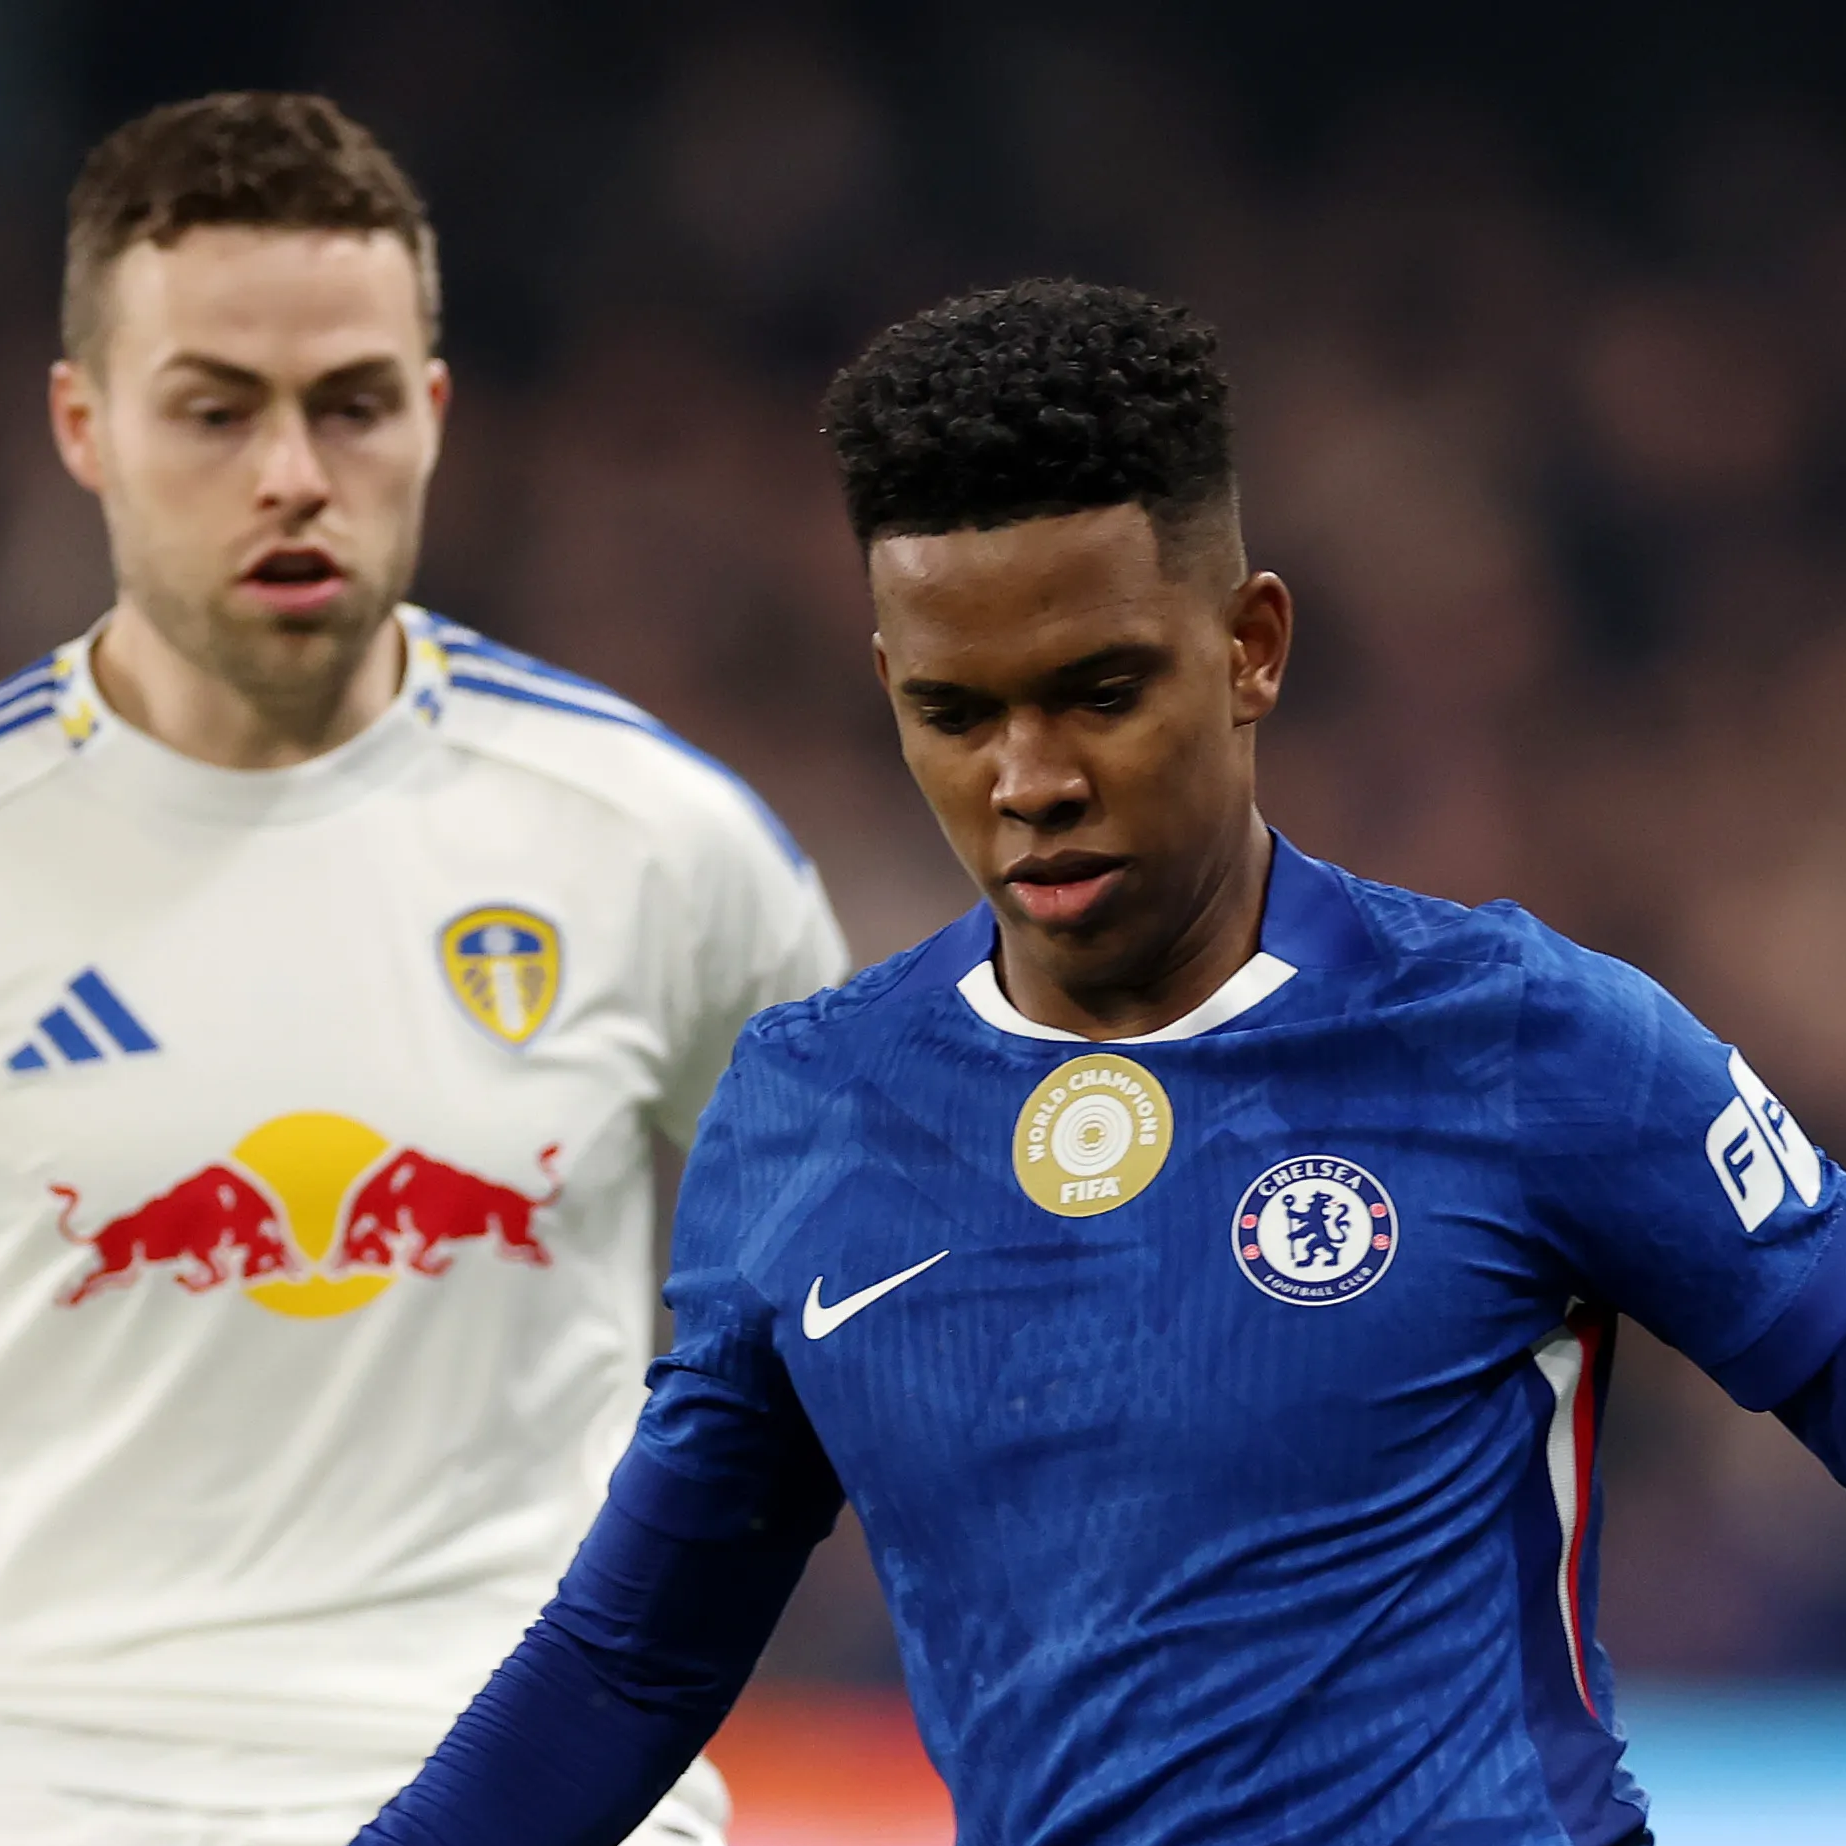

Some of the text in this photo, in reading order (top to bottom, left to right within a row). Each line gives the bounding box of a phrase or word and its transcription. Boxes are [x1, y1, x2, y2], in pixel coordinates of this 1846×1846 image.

[1027, 1069, 1159, 1163] WORLD CHAMPIONS
[1059, 1176, 1121, 1205] FIFA
[1257, 1161, 1363, 1196] CHELSEA
